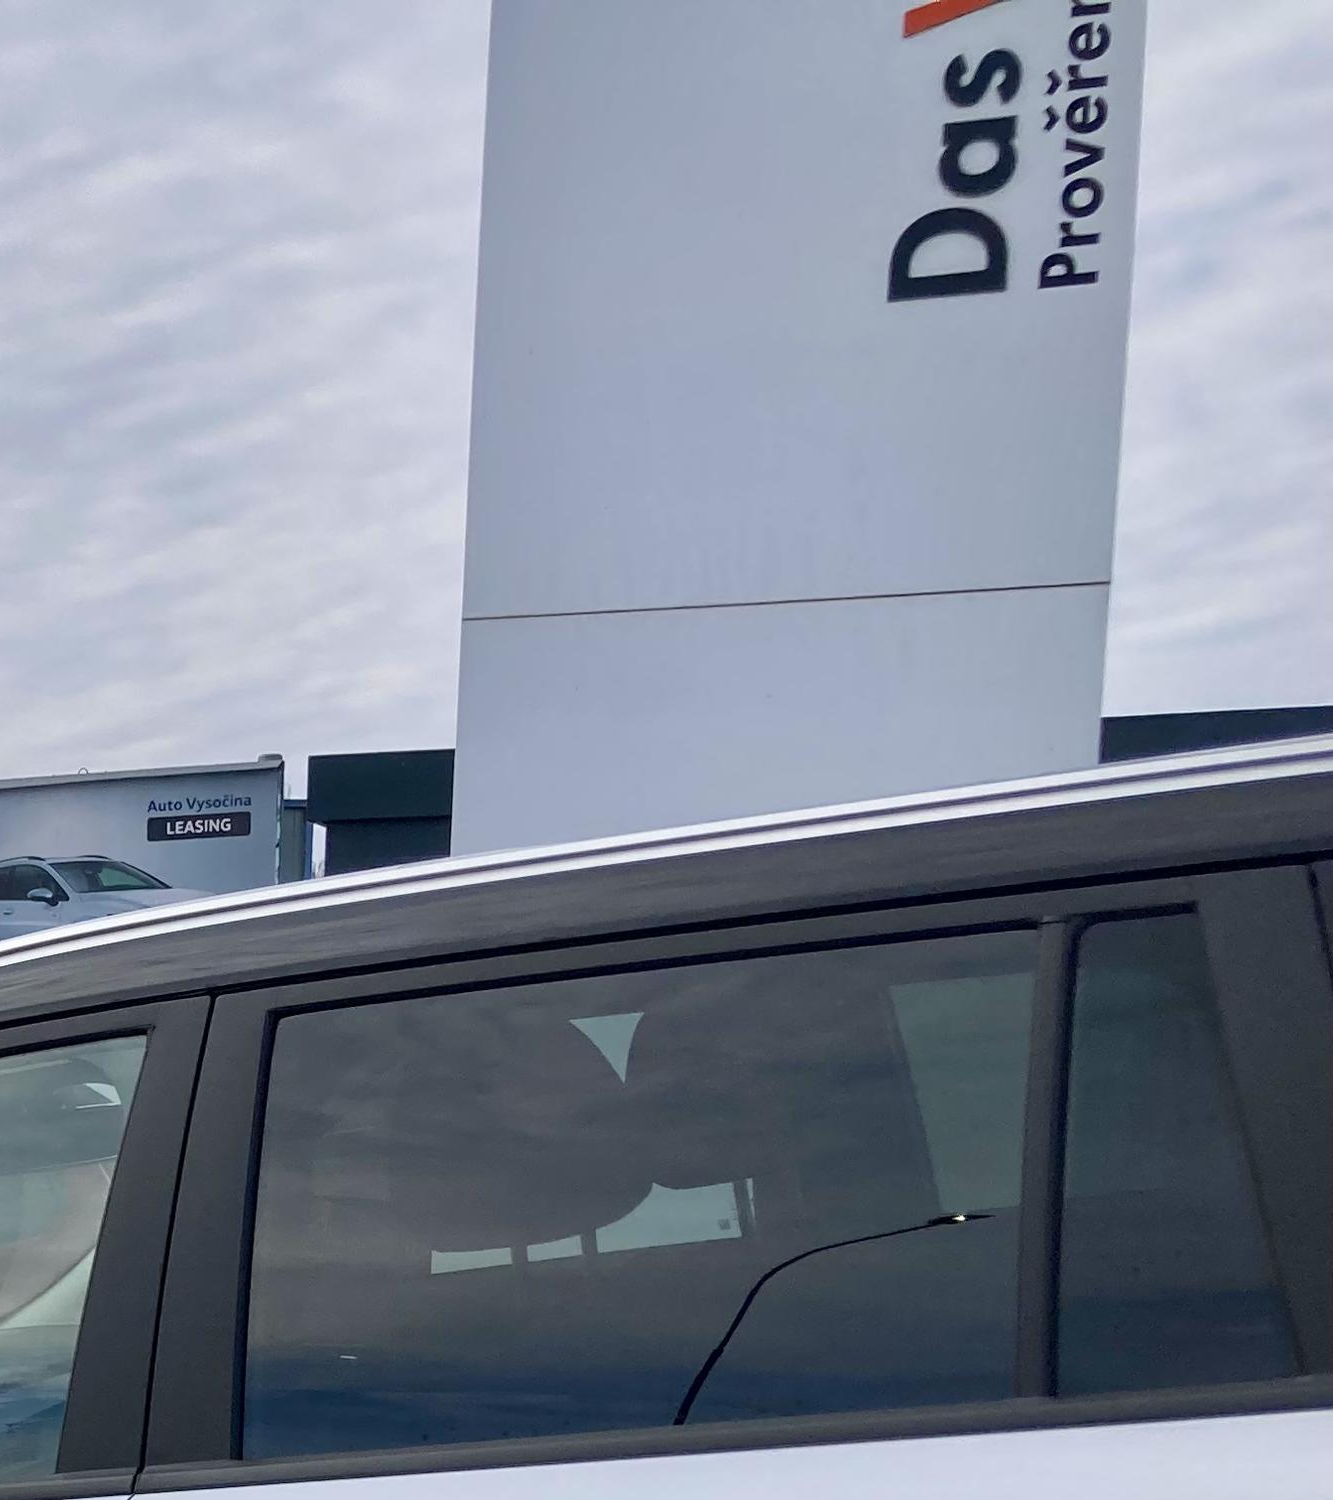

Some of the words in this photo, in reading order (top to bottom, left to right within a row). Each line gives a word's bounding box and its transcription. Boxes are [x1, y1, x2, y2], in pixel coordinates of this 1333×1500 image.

[887, 48, 1023, 303] Das
[147, 800, 183, 812] Auto
[186, 795, 252, 812] Vysočina
[166, 818, 232, 836] LEASING
